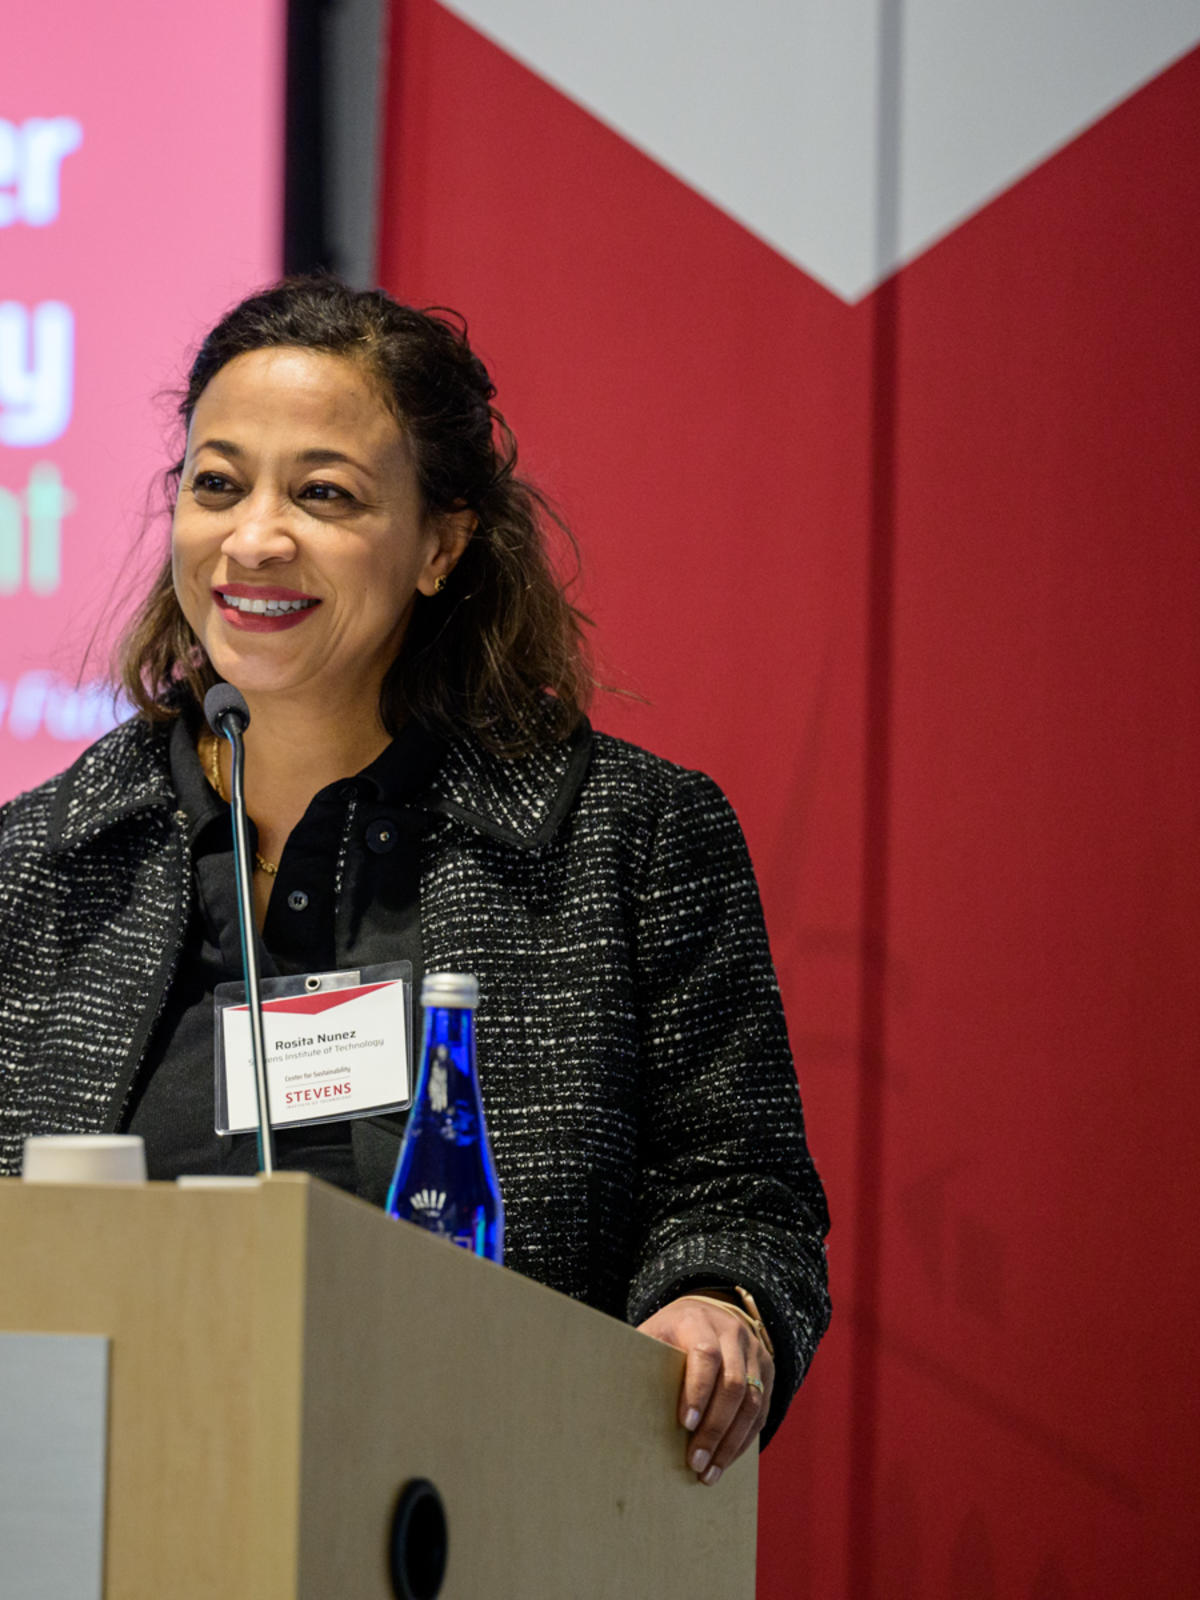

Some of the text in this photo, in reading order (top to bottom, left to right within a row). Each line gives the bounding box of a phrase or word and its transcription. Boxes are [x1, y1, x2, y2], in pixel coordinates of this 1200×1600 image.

[248, 1037, 385, 1066] Sens Institute of Technology
[275, 1030, 356, 1051] Rosita Nunez
[285, 1082, 352, 1104] STEVENS
